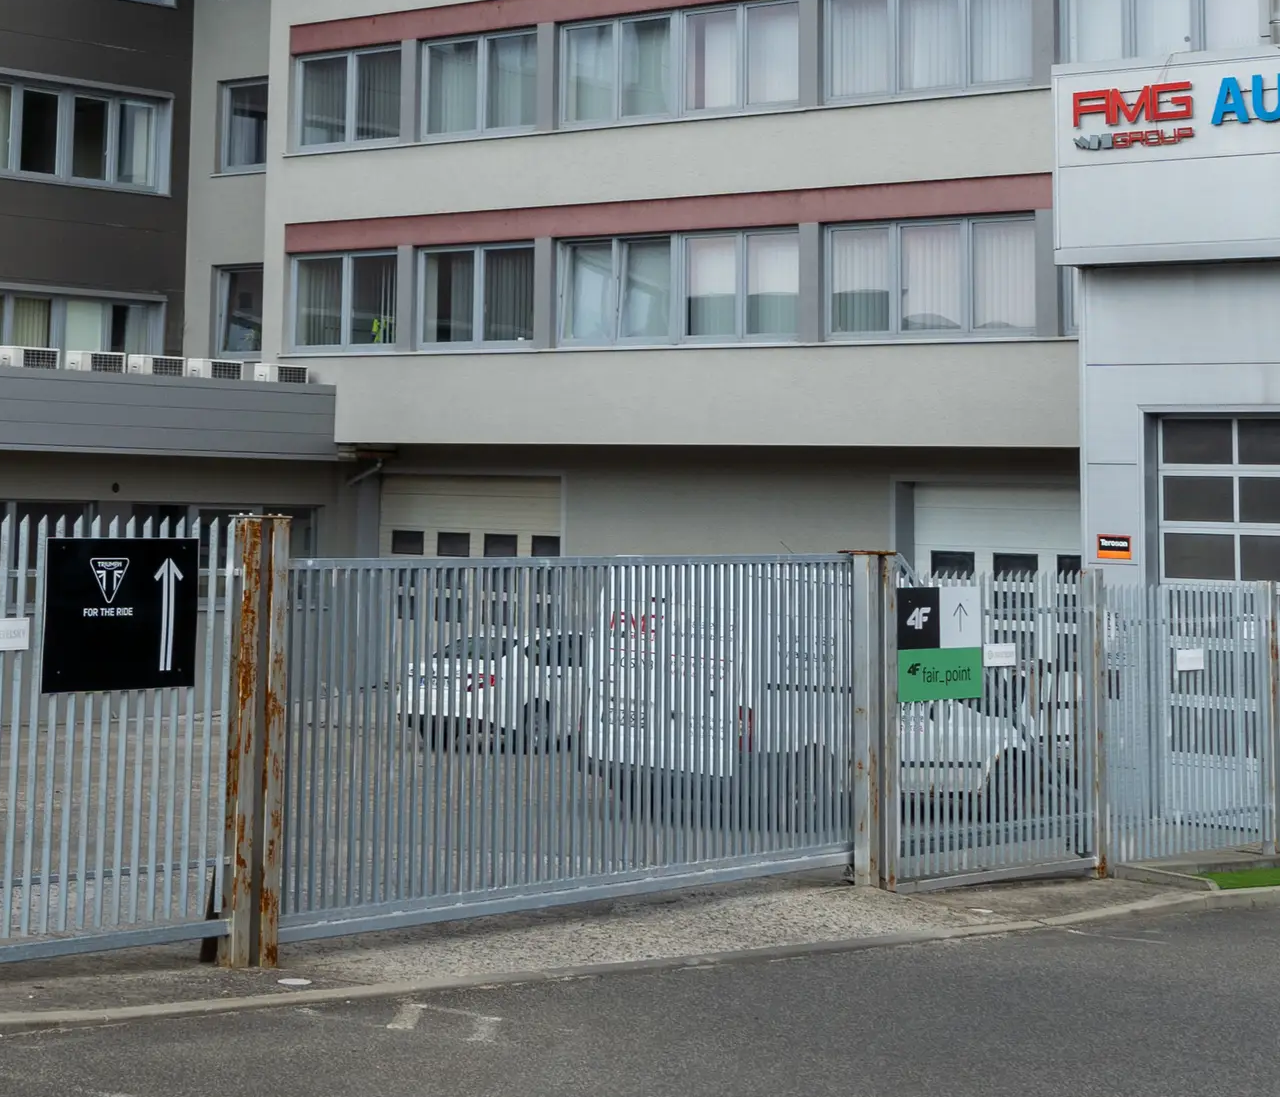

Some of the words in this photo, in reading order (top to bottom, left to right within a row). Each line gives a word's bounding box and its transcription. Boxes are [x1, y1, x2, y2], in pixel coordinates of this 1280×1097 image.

[1073, 81, 1193, 128] AMG
[1113, 127, 1194, 149] GROUP
[83, 608, 99, 617] FOR
[100, 607, 115, 617] THE
[116, 607, 133, 616] RIDE
[922, 666, 971, 686] fair_point
